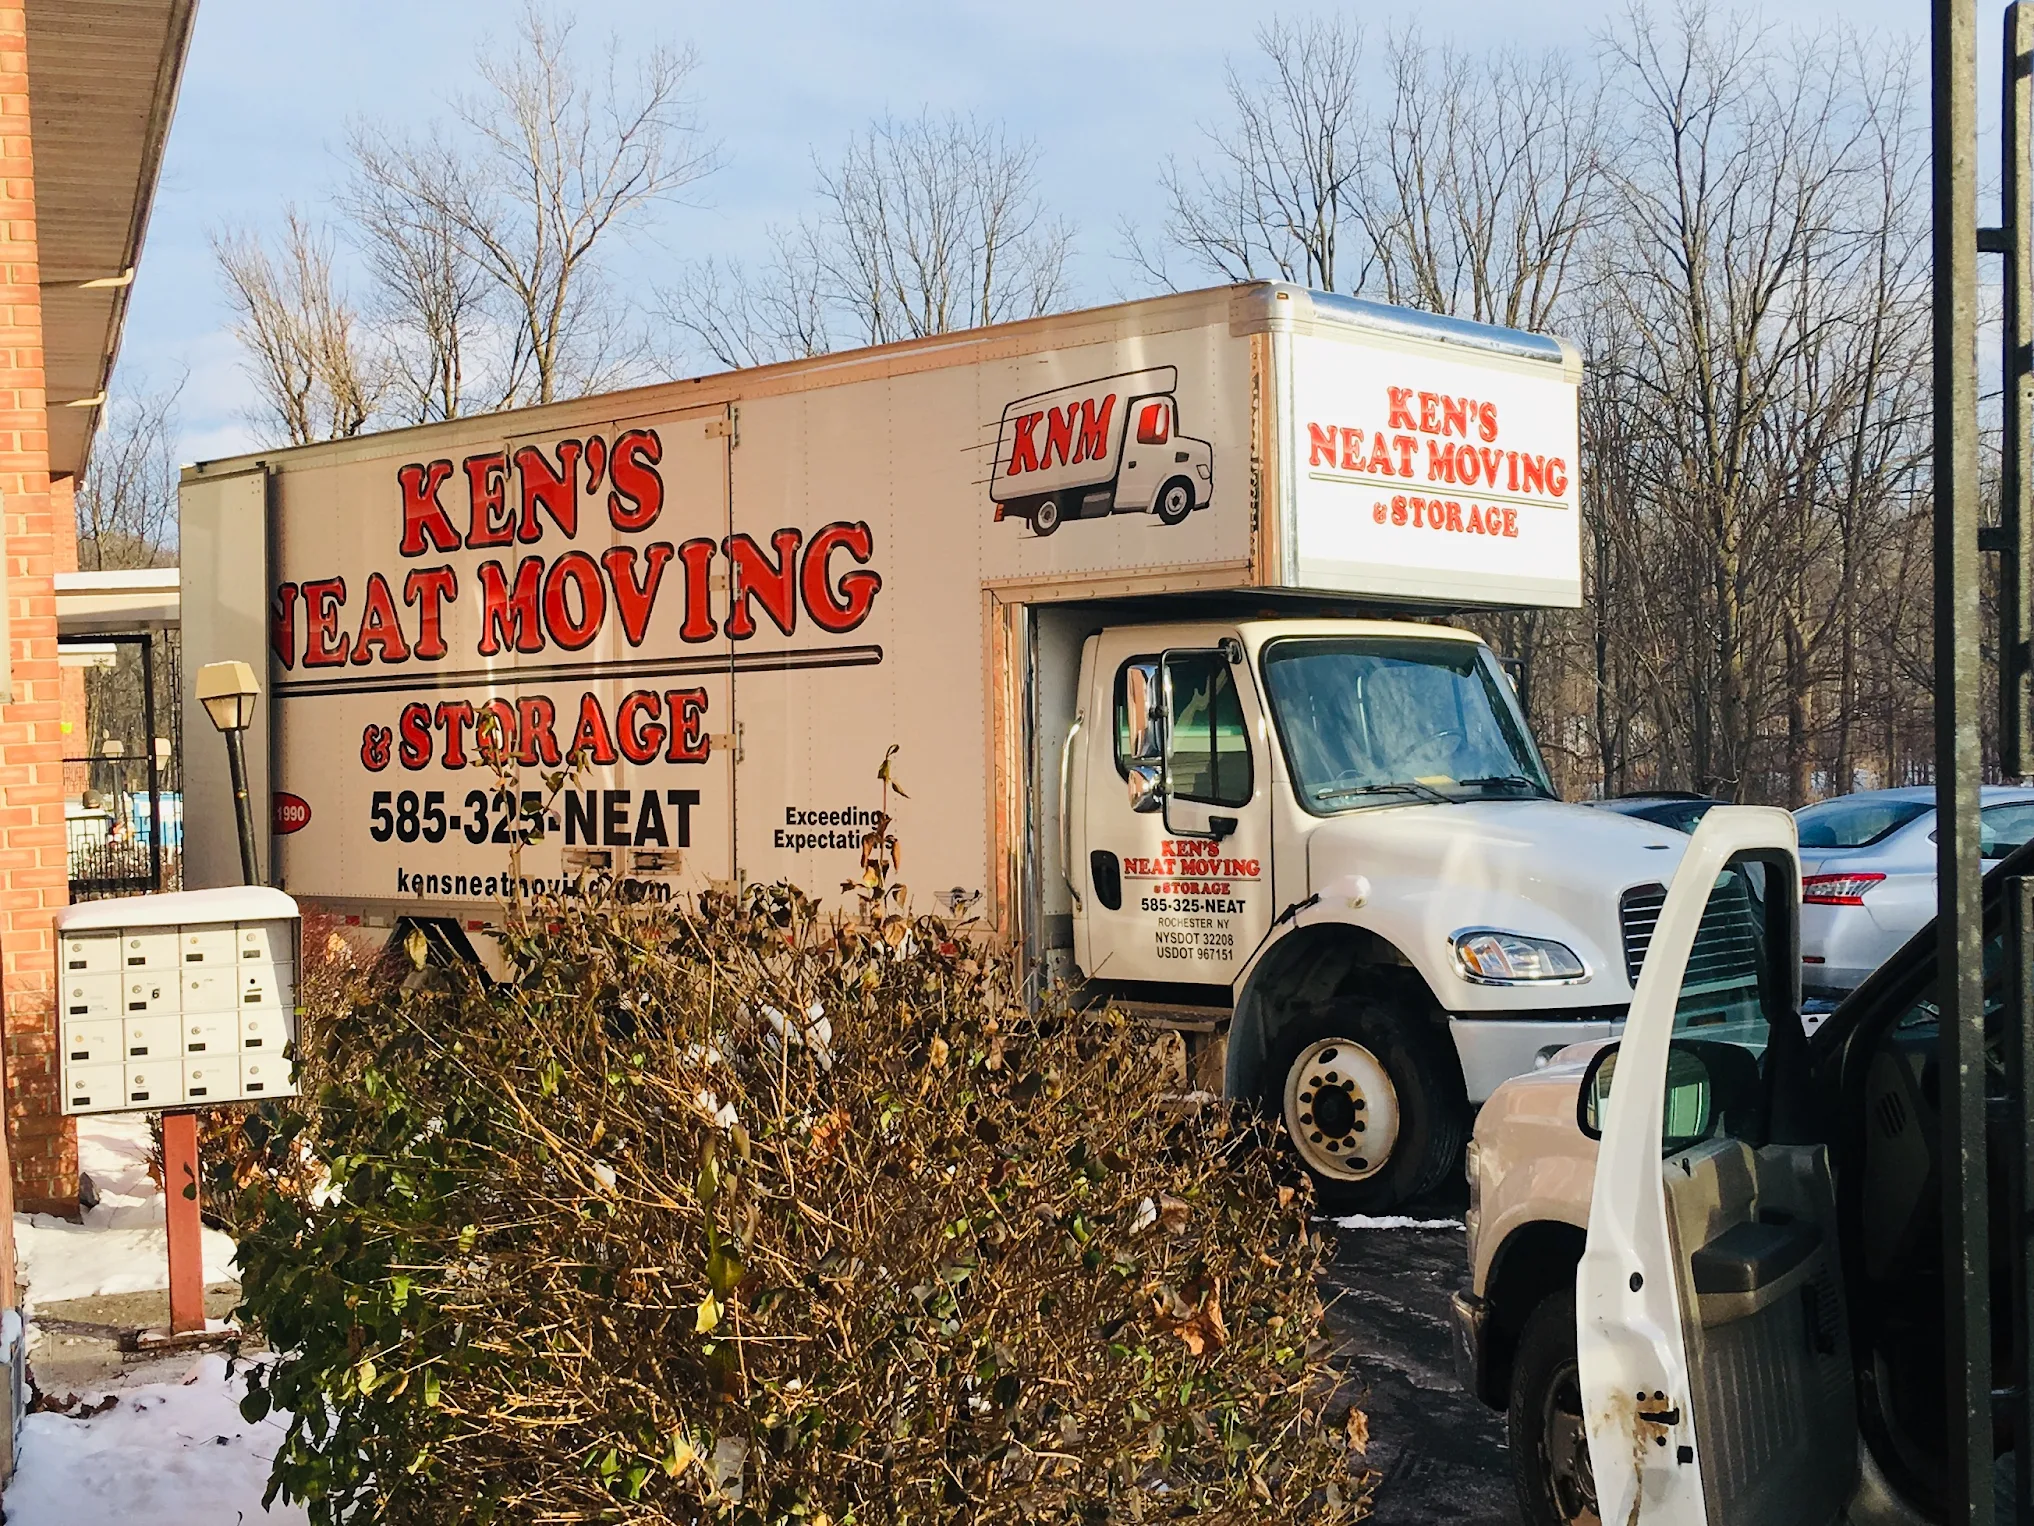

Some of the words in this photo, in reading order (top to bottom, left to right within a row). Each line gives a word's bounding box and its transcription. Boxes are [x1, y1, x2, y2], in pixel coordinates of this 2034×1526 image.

[1386, 386, 1498, 442] KEN'S
[1007, 393, 1116, 476] KNM
[1307, 422, 1418, 477] NEAT
[1426, 439, 1568, 497] MOVING
[398, 429, 664, 557] KEN'S
[478, 520, 883, 655] MOVING
[277, 805, 305, 821] 1990
[786, 806, 887, 830] Exceeding
[1161, 841, 1220, 857] KEN'S
[1124, 858, 1176, 875] NEAT
[1180, 859, 1261, 877] MOVING
[1158, 917, 1213, 929] ROCHESTER
[1217, 919, 1229, 929] NY
[1155, 932, 1199, 945] NYSDOT
[1203, 933, 1234, 946] 32208
[1156, 946, 1194, 960] USDOT
[1197, 948, 1233, 960] 967151
[152, 988, 160, 999] 6
